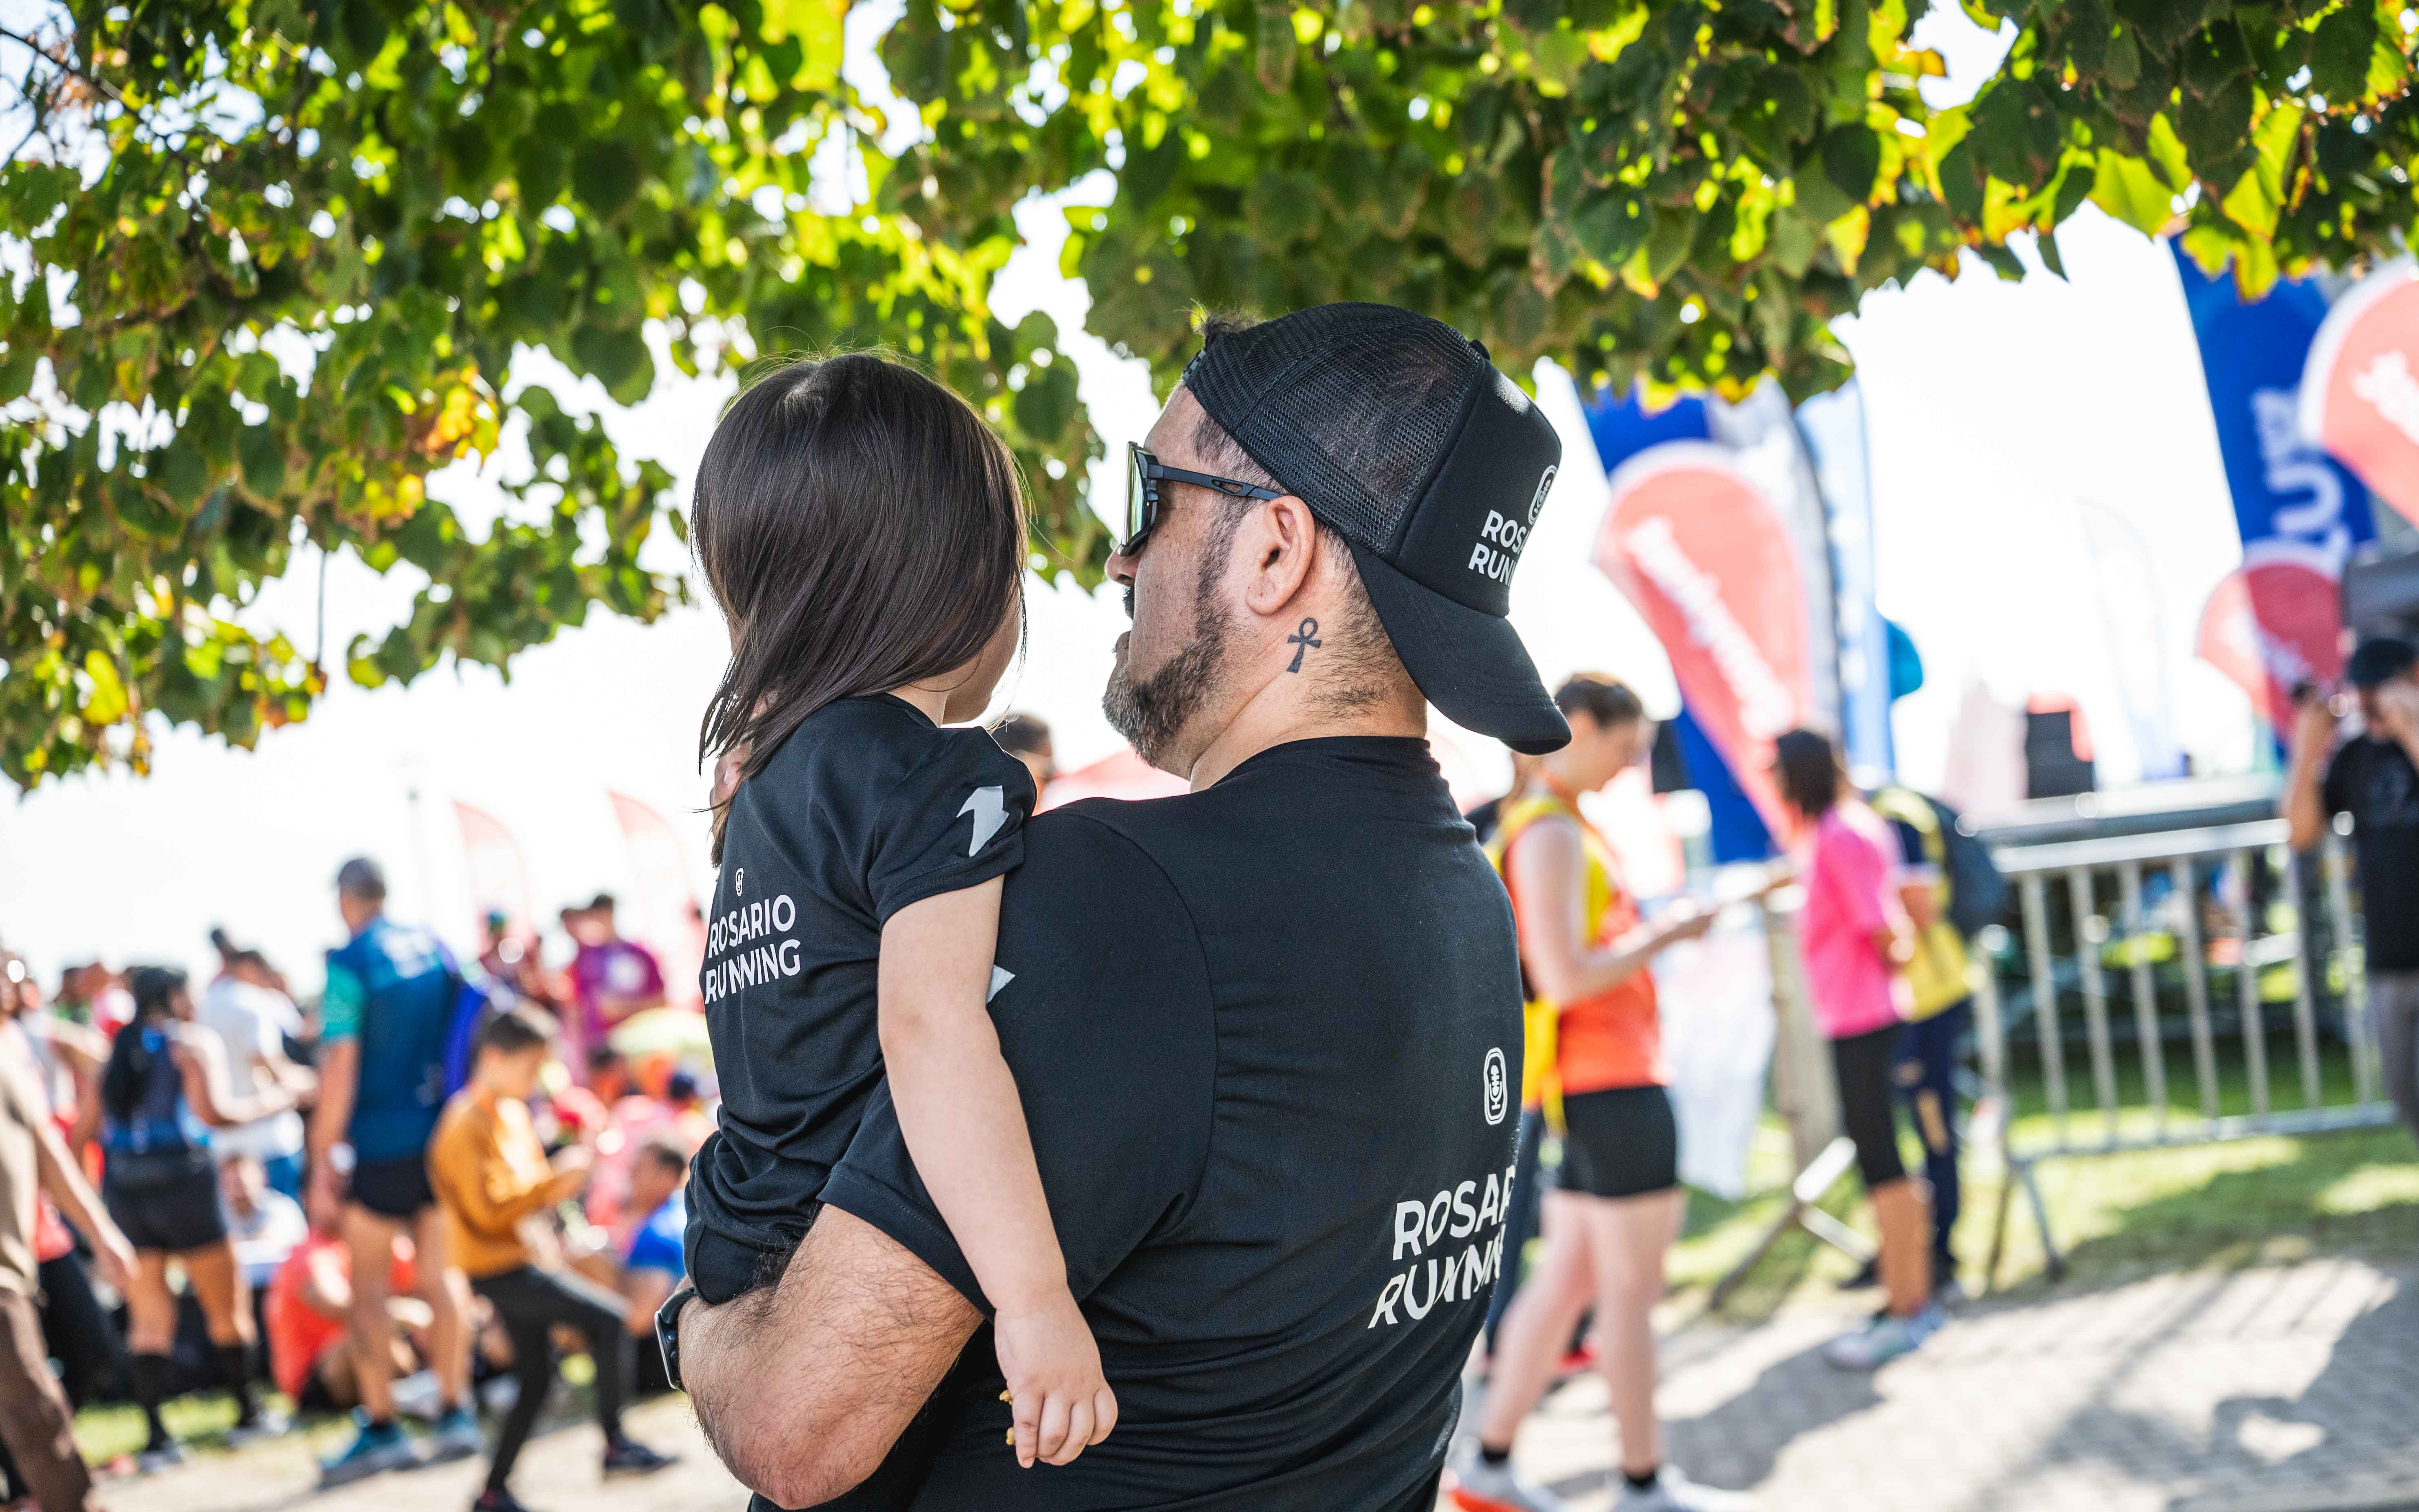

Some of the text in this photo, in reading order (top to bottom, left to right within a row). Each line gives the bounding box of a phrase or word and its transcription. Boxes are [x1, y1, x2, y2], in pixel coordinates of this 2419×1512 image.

[1468, 542, 1517, 586] RUN
[709, 895, 795, 959] ROSARIO
[705, 939, 801, 1004] RUNNING
